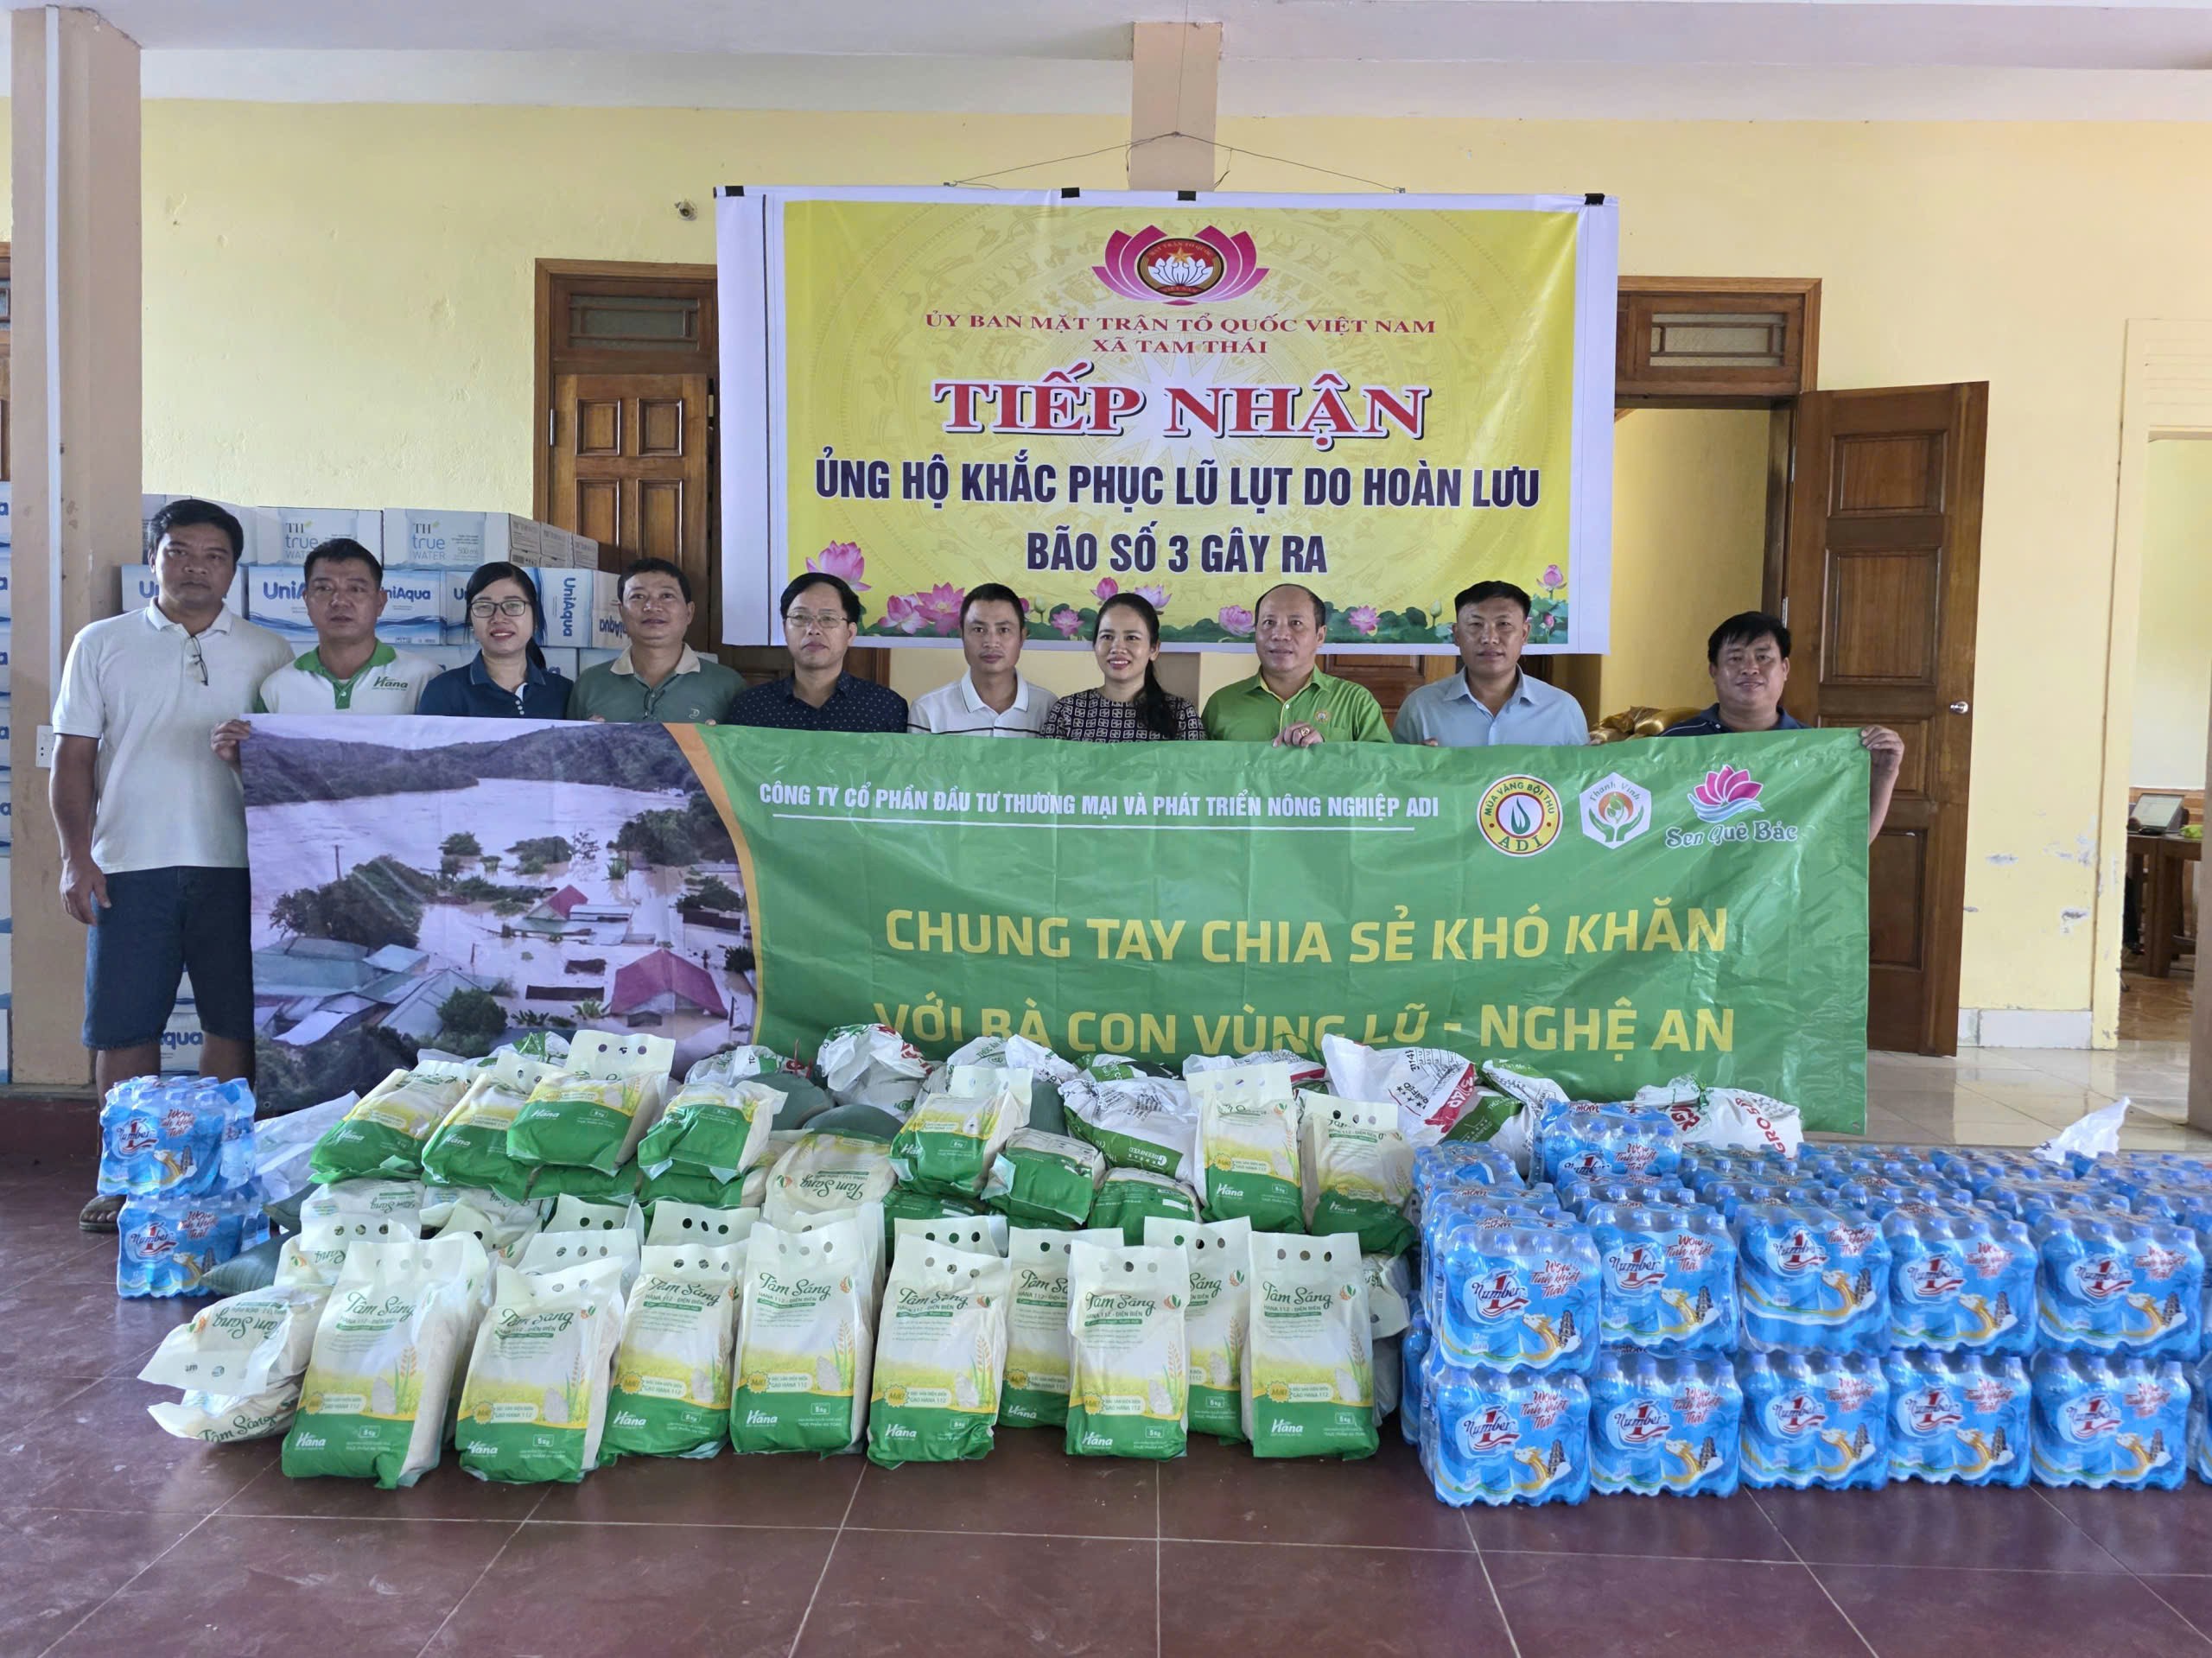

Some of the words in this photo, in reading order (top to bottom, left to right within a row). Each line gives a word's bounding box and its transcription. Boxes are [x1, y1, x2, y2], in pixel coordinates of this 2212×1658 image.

[925, 310, 961, 327] ỦY
[970, 314, 1022, 328] BAN
[1031, 314, 1090, 333] MẶT
[1096, 314, 1168, 334] TRẬN
[1177, 313, 1212, 332] TỔ
[1221, 314, 1297, 333] QUỐC
[1306, 316, 1367, 335] VIỆT
[1375, 321, 1435, 333] NAM
[1092, 336, 1127, 353] XÃ
[1136, 340, 1193, 353] TAM
[1203, 338, 1268, 353] THÁI
[932, 359, 1145, 435] TIẾP
[1163, 372, 1430, 449] NHẬN
[816, 446, 890, 499] ỦNG
[902, 454, 950, 509] HỘ
[962, 449, 1057, 503] KHẮC
[1069, 465, 1164, 513] PHỤC
[1176, 460, 1217, 505] LŨ
[1230, 467, 1293, 514] LỤT
[1305, 467, 1351, 506] DO
[1363, 460, 1462, 507] HOÀN
[1472, 467, 1540, 508] LƯU
[285, 522, 305, 533] TH
[414, 523, 431, 534] TH
[285, 536, 319, 549] true
[412, 535, 446, 549] true
[1027, 525, 1098, 572] BÃO
[1110, 520, 1160, 573] SỐ
[1168, 535, 1189, 573] 3
[1201, 527, 1270, 573] GÂY
[1281, 535, 1328, 574] RA
[413, 551, 446, 561] WATER
[264, 581, 304, 600] UniA
[560, 577, 576, 637] UniAqua
[760, 781, 810, 805] CÔNG
[817, 785, 838, 807] TY
[844, 782, 871, 808] CỔ
[876, 785, 928, 810] PHẦN
[933, 785, 970, 812] ĐẦU
[976, 791, 1001, 812] TƯ
[1003, 792, 1076, 815] THƯƠNG
[1082, 795, 1118, 821] MẠI
[1123, 792, 1147, 816] VÀ
[1154, 792, 1201, 816] PHÁT
[1206, 789, 1262, 816] TRIỂN
[1268, 793, 1321, 817] NÔNG
[1328, 793, 1400, 822] NGHIỆP
[1406, 797, 1439, 817] ADI
[1484, 797, 1498, 816] MÙA
[1497, 782, 1524, 796] VÀNG
[1527, 784, 1544, 796] BỘI
[1543, 795, 1554, 814] THU
[1498, 835, 1543, 852] ADI
[1666, 827, 1705, 848] Sen
[1707, 823, 1749, 846] Quê
[886, 909, 1071, 957] CHUNG
[1086, 918, 1186, 962] TAY
[1202, 919, 1333, 963] CHIA
[1350, 905, 1416, 963] SẺ
[1432, 904, 1550, 961] KHÓ
[1564, 897, 1727, 954] KHĂN
[874, 991, 963, 1043] VỚI
[981, 997, 1052, 1049] BÀ
[1067, 1010, 1177, 1055] CON
[1192, 1004, 1346, 1055] VÙNG
[1363, 1002, 1430, 1045] LŨ
[1443, 1022, 1462, 1032] -
[1481, 996, 1637, 1062] NGHỆ
[1650, 1008, 1734, 1052] AN
[1216, 1183, 1244, 1197] Hana
[1609, 1254, 1660, 1275] Number
[760, 1272, 790, 1295] Tâm
[791, 1279, 831, 1301] Sáng
[1020, 1269, 1049, 1291] Tâm
[1190, 1272, 1223, 1298] Sáng
[1471, 1280, 1525, 1301] Number
[682, 1283, 721, 1307] Sáng
[899, 1287, 931, 1305] Tâm
[1262, 1280, 1291, 1304] Tâm
[1294, 1286, 1333, 1310] Sáng
[345, 1292, 378, 1315] Tâm
[378, 1296, 416, 1322] Sáng
[613, 1410, 647, 1426] Hana
[747, 1410, 779, 1425] Hana
[1271, 1418, 1304, 1433] Hana
[1464, 1416, 1516, 1437] Number
[1614, 1410, 1666, 1431] Number
[296, 1432, 327, 1447] Hana
[885, 1424, 918, 1439] Hana
[1082, 1431, 1114, 1446] Hana
[467, 1440, 499, 1455] Hana
